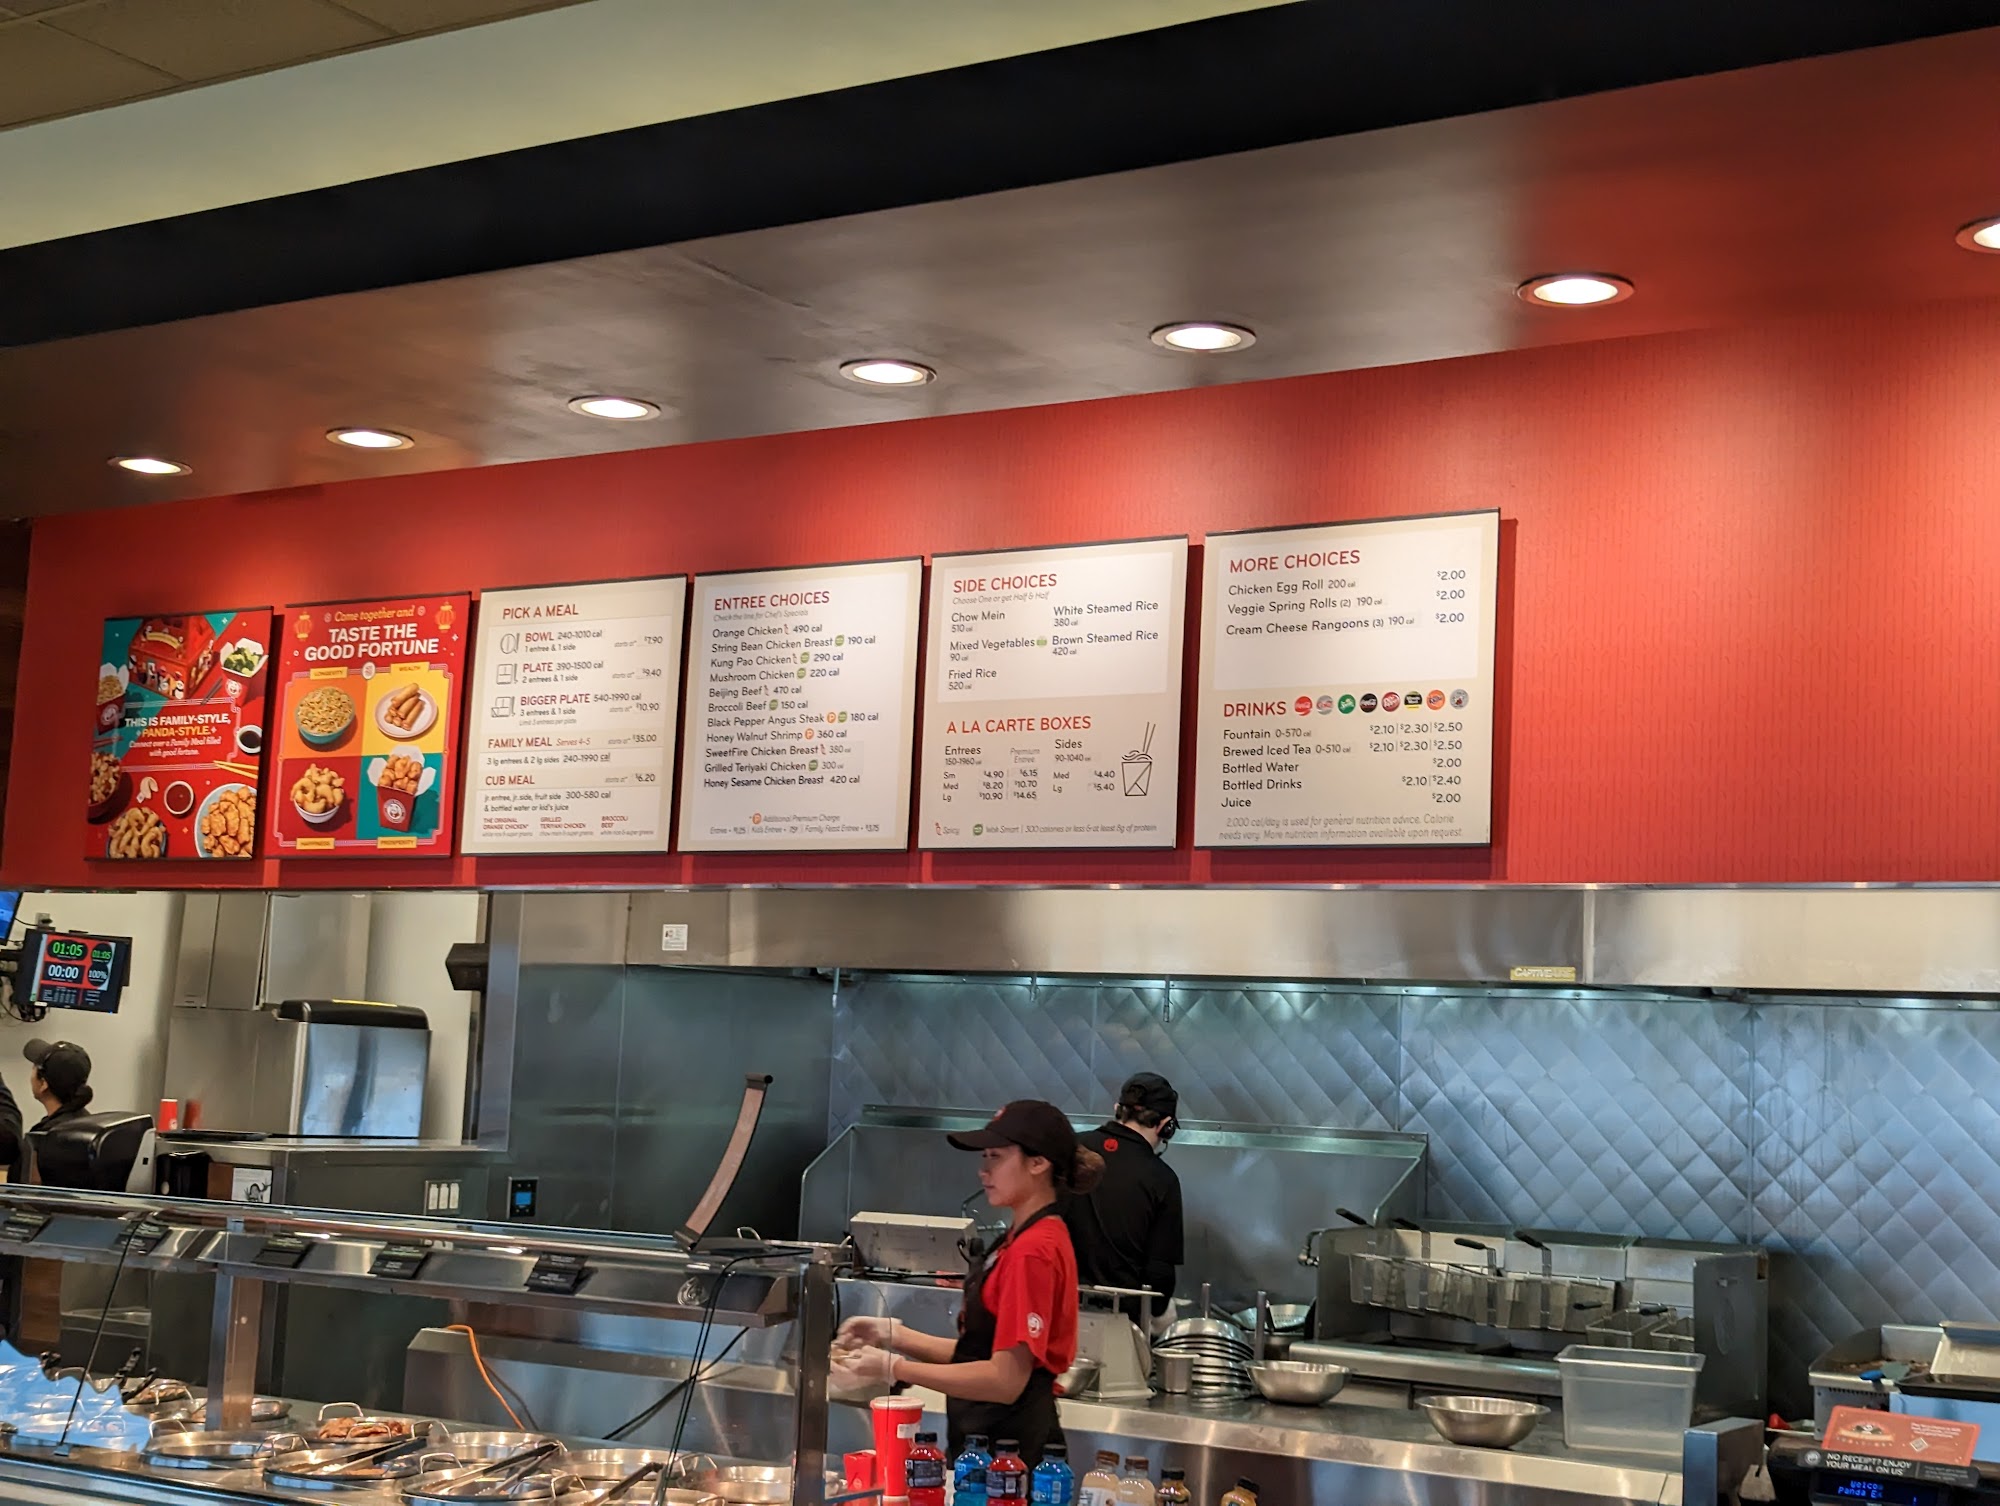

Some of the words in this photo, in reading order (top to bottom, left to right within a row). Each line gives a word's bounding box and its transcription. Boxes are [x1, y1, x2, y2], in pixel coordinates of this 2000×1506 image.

[1230, 556, 1279, 573] MORE
[1284, 550, 1360, 569] CHOICES
[954, 579, 986, 593] SIDE
[991, 574, 1057, 591] CHOICES
[1229, 584, 1272, 595] Chicken
[1277, 582, 1298, 594] Egg
[1302, 579, 1323, 590] Roll
[715, 596, 766, 611] ENTREE
[770, 591, 829, 607] CHOICES
[1228, 603, 1265, 616] Veggie
[1269, 601, 1305, 613] Spring
[1310, 598, 1337, 609] Rolls
[334, 609, 357, 622] Come
[359, 608, 394, 622] together
[397, 606, 415, 618] and
[1053, 606, 1083, 616] White
[1087, 602, 1132, 614] Steamed
[1136, 601, 1158, 610] Rice
[951, 613, 978, 622] Chow
[981, 611, 1005, 620] Mein
[329, 629, 378, 644] TASTE
[383, 623, 417, 640] THE
[712, 629, 745, 639] Orange
[747, 626, 783, 636] Chicken
[793, 624, 809, 633] 490
[1226, 625, 1262, 635] Cream
[1266, 623, 1307, 633] Cheese
[1312, 620, 1369, 632] Rangoons
[950, 640, 979, 650] Mixed
[981, 637, 1035, 651] Vegetables
[1052, 635, 1083, 645] Brown
[1087, 631, 1132, 643] Steamed
[1136, 630, 1158, 640] Rice
[305, 644, 353, 661] GOOD
[359, 639, 438, 657] FORTUNE
[712, 643, 738, 654] String
[741, 642, 763, 651] Bean
[766, 640, 801, 650] Chicken
[804, 638, 833, 647] Breast
[848, 636, 862, 644] 190
[711, 659, 733, 669] Kung
[737, 657, 753, 666] Pao
[756, 656, 791, 665] Chicken
[814, 653, 830, 662] 290
[710, 673, 756, 682] Mushroom
[759, 670, 794, 680] Chicken
[810, 669, 826, 677] 220
[949, 669, 972, 679] Fried
[976, 668, 997, 678] Rice
[709, 688, 738, 699] Beijing
[742, 686, 762, 696] Beef
[773, 686, 789, 694] 470
[708, 702, 743, 712] Broccoli
[746, 701, 767, 711] Beef
[781, 701, 795, 709] 150
[1224, 701, 1286, 717] DRINKS
[125, 717, 147, 727] THIS
[149, 716, 158, 726] IS
[707, 718, 731, 727] Black
[734, 717, 765, 727] Pepper
[768, 716, 796, 726] Angus
[799, 714, 824, 723] Steak
[851, 713, 865, 721] 180
[947, 721, 957, 734] A
[962, 720, 981, 733] LA
[986, 718, 1035, 732] CARTE
[1041, 716, 1091, 730] BOXES
[707, 734, 734, 743] Honey
[737, 732, 767, 741] Walnut
[770, 731, 802, 741] Shrimp
[817, 730, 834, 738] 360
[1224, 729, 1270, 740] Fountain
[945, 746, 981, 755] Entrees
[1055, 739, 1082, 749] Sides
[1223, 745, 1263, 757] Brewed
[1267, 745, 1290, 755] Iced
[1292, 744, 1311, 754] Tea
[706, 747, 748, 758] SweetFire
[751, 747, 786, 756] Chicken
[790, 745, 818, 755] Breast
[705, 763, 733, 773] Grilled
[735, 763, 767, 773] Teriyaki
[770, 762, 806, 771] Chicken
[1223, 763, 1262, 773] Bottled
[1266, 762, 1299, 772] Water
[704, 779, 728, 789] Honey
[731, 777, 762, 787] Sesame
[764, 776, 796, 786] Chicken
[798, 775, 824, 785] Breast
[830, 775, 847, 784] 420
[1223, 780, 1262, 790] Bottled
[1267, 779, 1302, 789] Drinks
[1221, 797, 1251, 807] Juice
[53, 942, 82, 956] 01:05
[92, 950, 111, 959] 01:05
[48, 965, 78, 979] 00:00
[88, 970, 107, 979] 100%
[1842, 1456, 1881, 1464] RECEIPT?
[1851, 1464, 1874, 1472] MEAL
